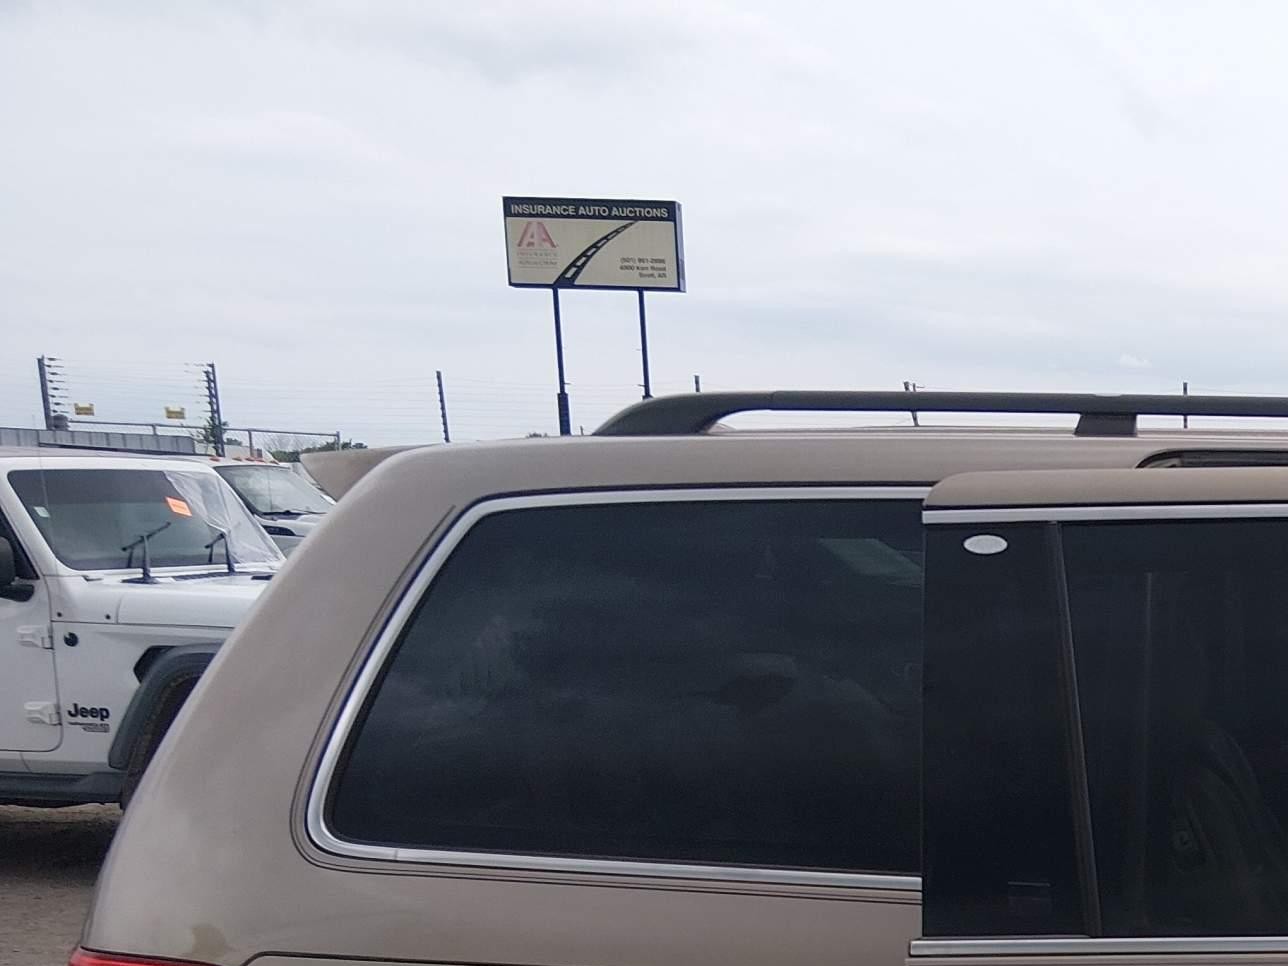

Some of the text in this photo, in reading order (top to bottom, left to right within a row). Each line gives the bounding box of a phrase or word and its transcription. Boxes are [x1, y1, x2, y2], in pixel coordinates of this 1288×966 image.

[511, 204, 669, 218] INSURANCE AUTO AUCTIONS
[67, 702, 110, 721] Jeep
